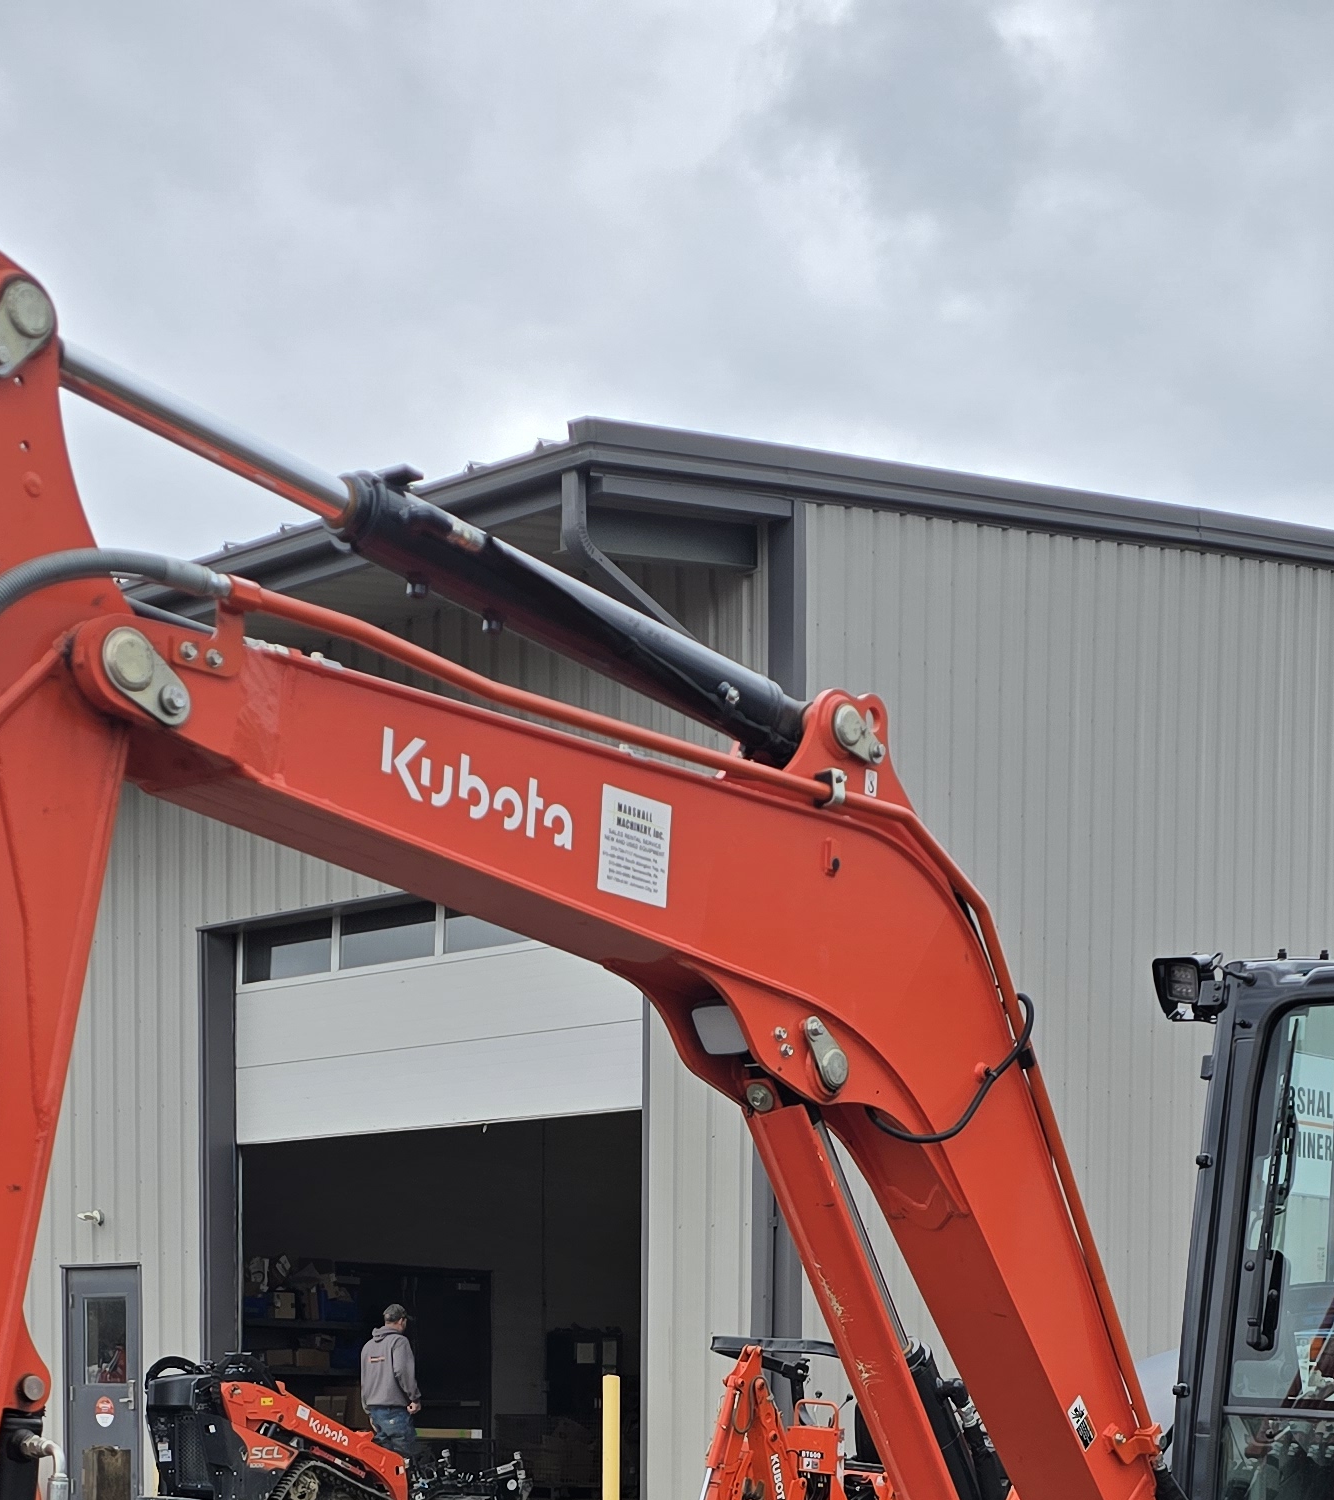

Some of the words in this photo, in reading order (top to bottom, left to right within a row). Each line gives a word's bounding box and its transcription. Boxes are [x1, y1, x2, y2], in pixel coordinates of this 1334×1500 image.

[381, 726, 573, 850] Kubota
[617, 802, 653, 822] MARSHALL
[308, 1417, 349, 1447] Kubota
[249, 1446, 283, 1459] SCL
